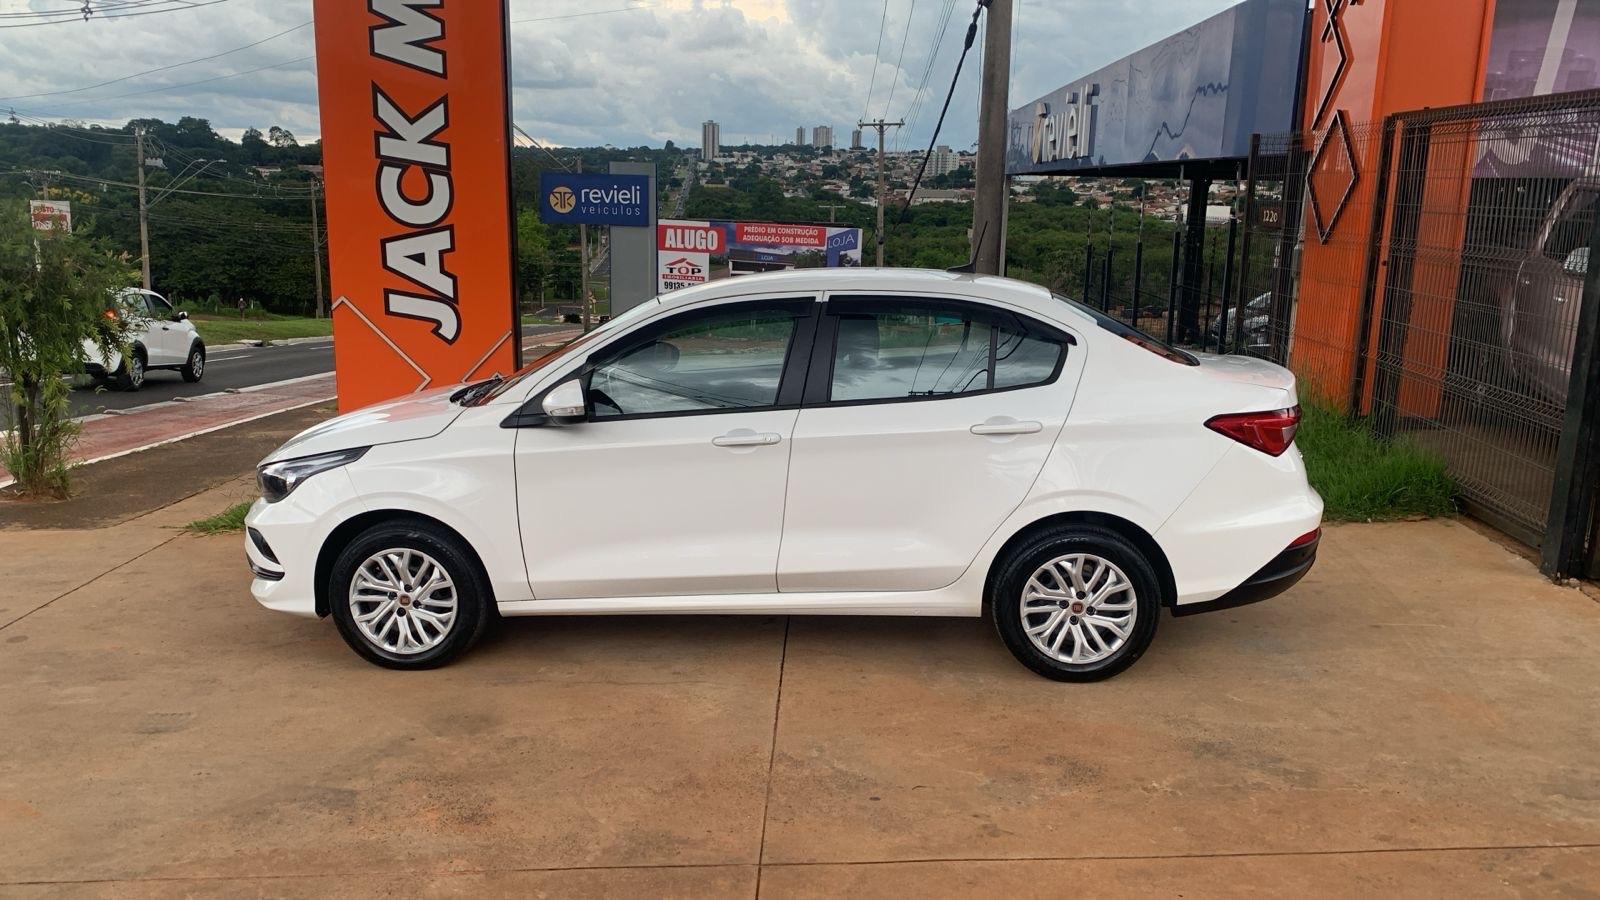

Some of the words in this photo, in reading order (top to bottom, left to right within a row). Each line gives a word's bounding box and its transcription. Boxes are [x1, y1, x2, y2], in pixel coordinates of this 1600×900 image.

[581, 185, 640, 204] revieli
[371, 80, 461, 345] JACK
[1263, 210, 1278, 222] 1220
[744, 225, 766, 233] PRÉDIO
[778, 227, 818, 236] CONSTRUÇÃO
[665, 228, 718, 250] ALUGO
[743, 234, 780, 243] ADEQUAÇÃO
[829, 233, 855, 248] LOJA
[666, 266, 702, 275] TOP
